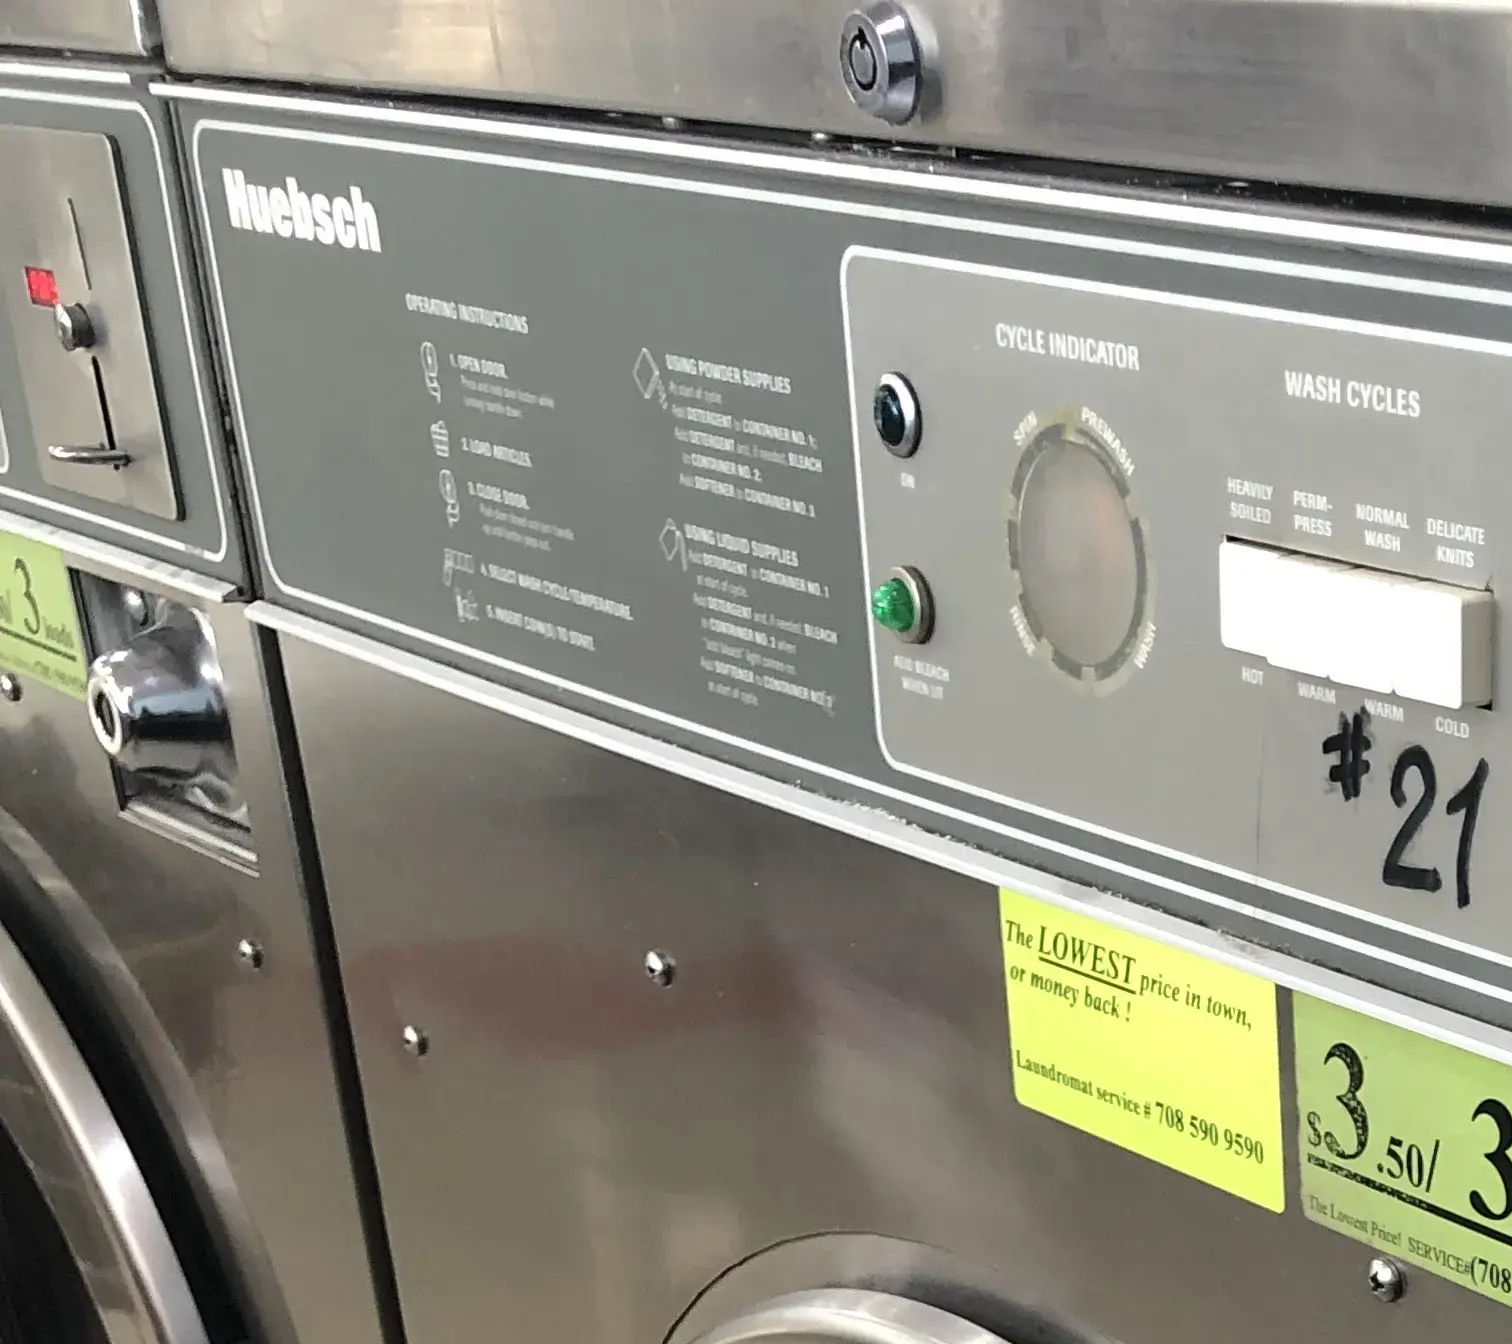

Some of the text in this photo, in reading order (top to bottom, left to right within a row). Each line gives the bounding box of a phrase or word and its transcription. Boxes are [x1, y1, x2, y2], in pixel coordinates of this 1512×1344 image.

[221, 167, 382, 253] Huebsch
[995, 322, 1140, 371] CYCLE INDICATOR
[698, 359, 741, 385] POWDER
[742, 367, 791, 395] SUPPLIES
[1284, 370, 1421, 418] WASH CYCLES
[1013, 410, 1038, 447] SPIN
[1080, 406, 1136, 477] PREWASH
[1227, 477, 1274, 501] HEAVILY
[1293, 490, 1333, 512] PERM-
[1230, 501, 1271, 524] SOILED
[1293, 515, 1333, 537] PRESS
[1355, 503, 1410, 530] NORMAL
[1364, 529, 1401, 552] WASH
[1427, 517, 1485, 545] DELICATE
[751, 540, 799, 567] SUPPLIES
[1436, 545, 1475, 568] KNITS
[14, 557, 40, 635] 3
[1008, 605, 1036, 658] RINSE
[1134, 620, 1157, 670] WASH
[914, 660, 950, 682] BLEACH
[1241, 666, 1264, 686] HOT
[1297, 681, 1336, 704] WARM
[1364, 698, 1404, 722] WARM
[1435, 717, 1469, 739] COLD
[1005, 919, 1253, 1032] The LOWEST price in town,
[1009, 964, 1132, 1022] or money back !
[1015, 1049, 1264, 1165] Laundromat service # 708 590 9590
[1309, 1195, 1328, 1216] The
[1330, 1203, 1369, 1234] Lowest
